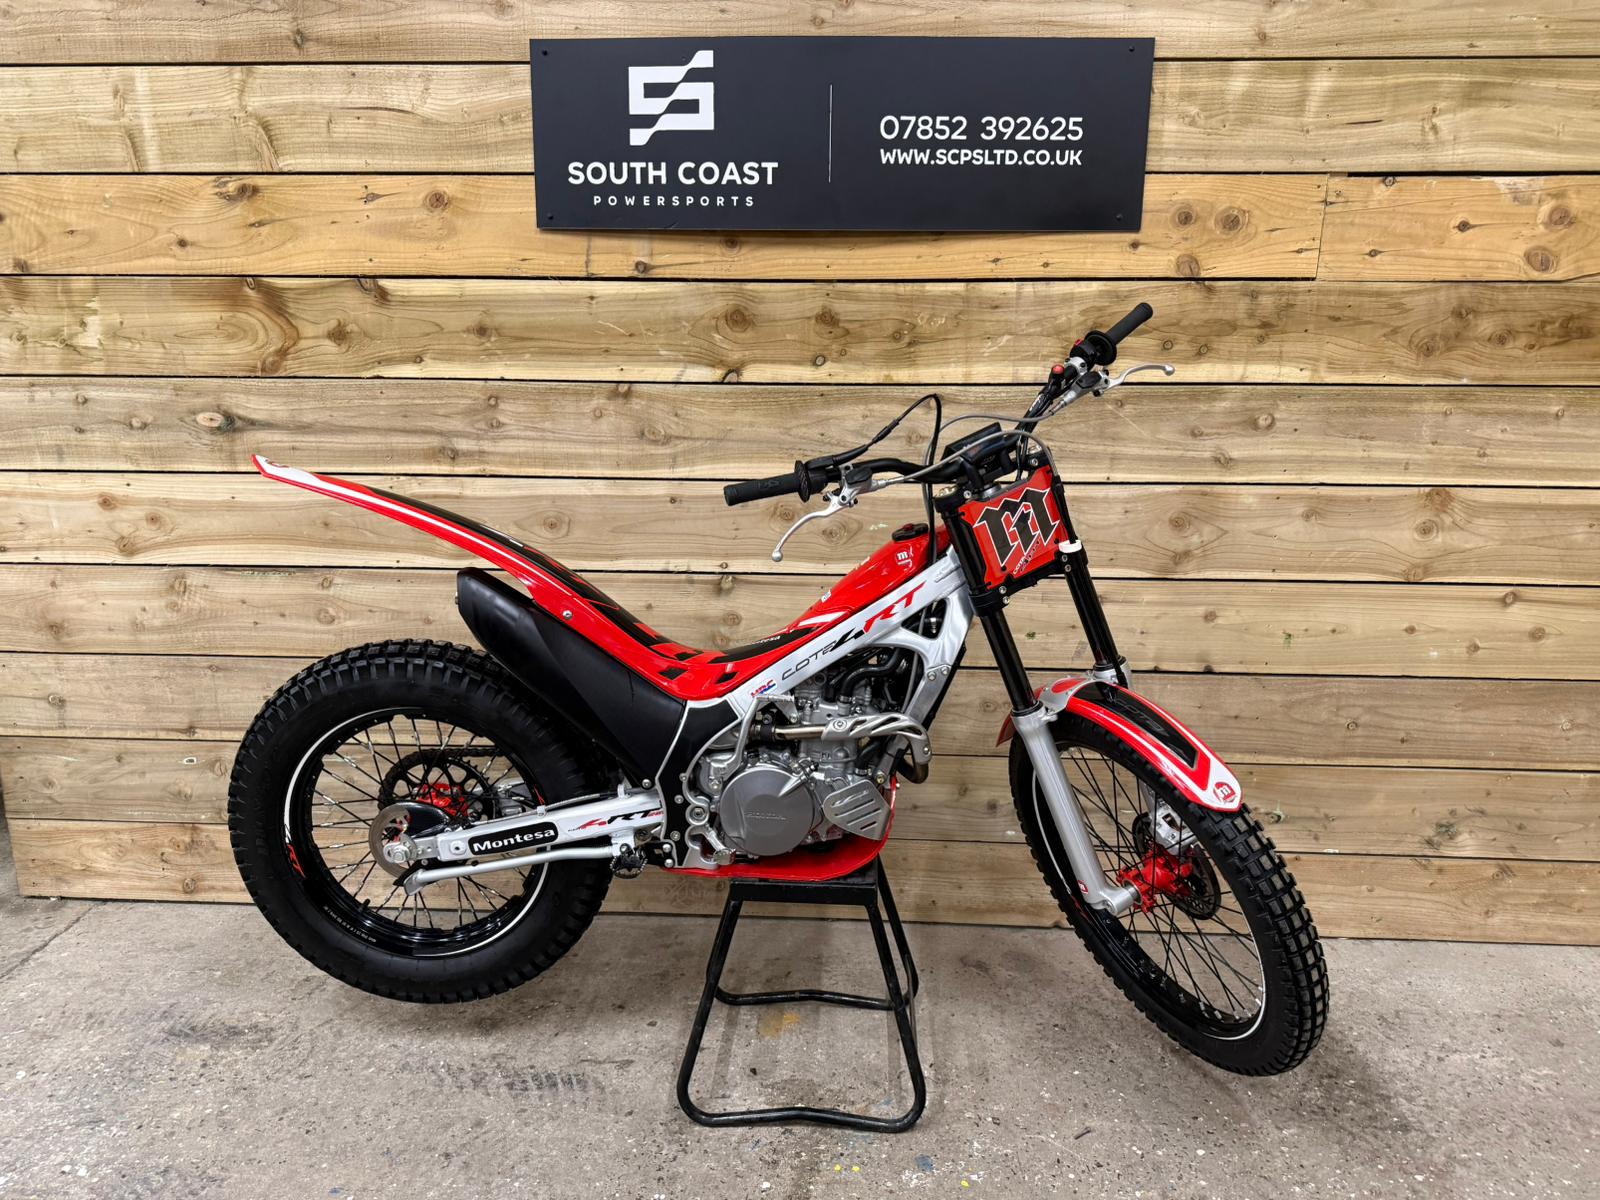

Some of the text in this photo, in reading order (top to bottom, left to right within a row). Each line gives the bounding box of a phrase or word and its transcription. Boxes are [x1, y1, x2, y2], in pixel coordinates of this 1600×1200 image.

[880, 116, 1084, 140] 07852 392625
[880, 149, 1083, 165] WWW.SCPSLTD.CO.UK
[567, 162, 779, 184] SOUTH COAST
[593, 196, 754, 207] POWERSPORTS
[473, 829, 556, 852] Montesa
